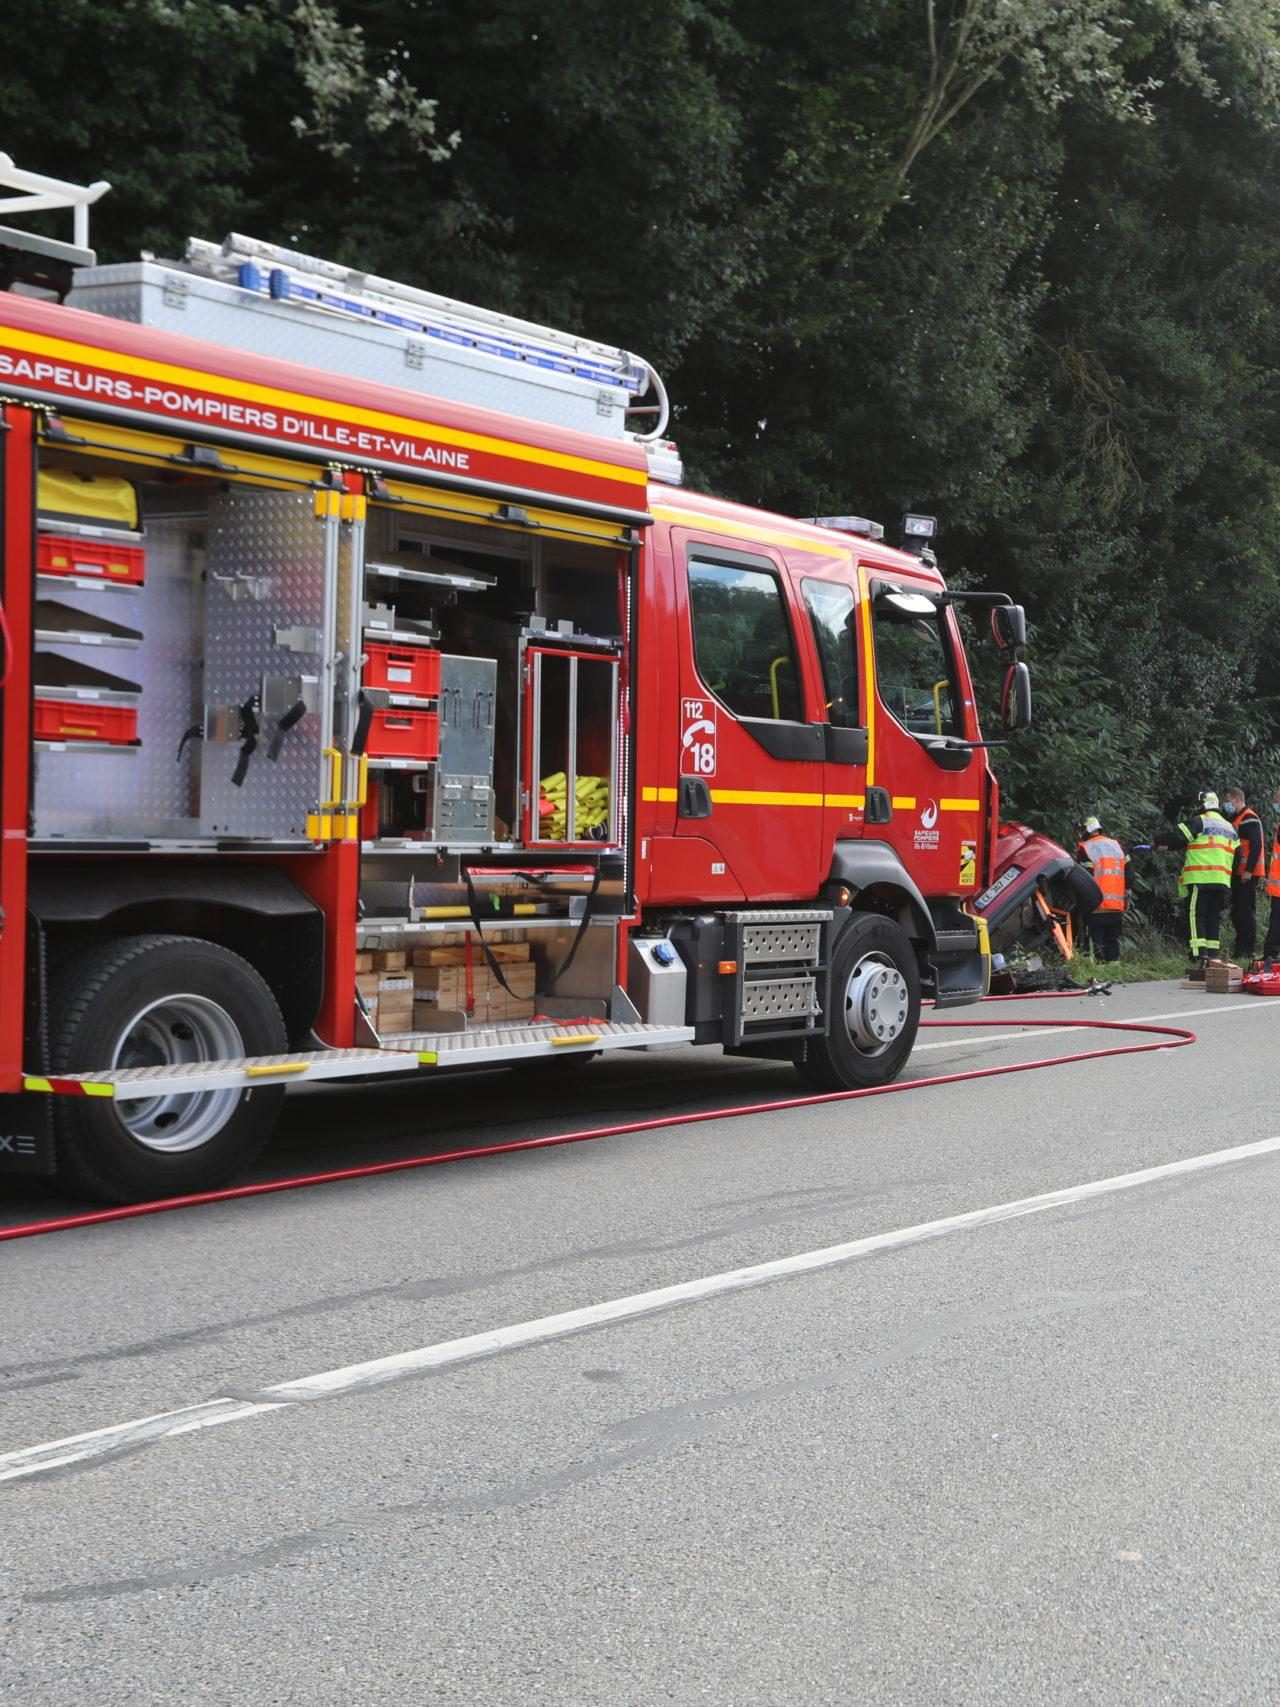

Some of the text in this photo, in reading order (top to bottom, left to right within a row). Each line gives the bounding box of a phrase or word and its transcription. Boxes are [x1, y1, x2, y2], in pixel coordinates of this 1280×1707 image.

[0, 354, 470, 470] SAPEURS-POMPIERS D'ILLE-ET-VILAINE
[684, 701, 704, 719] 112
[690, 742, 715, 773] 18
